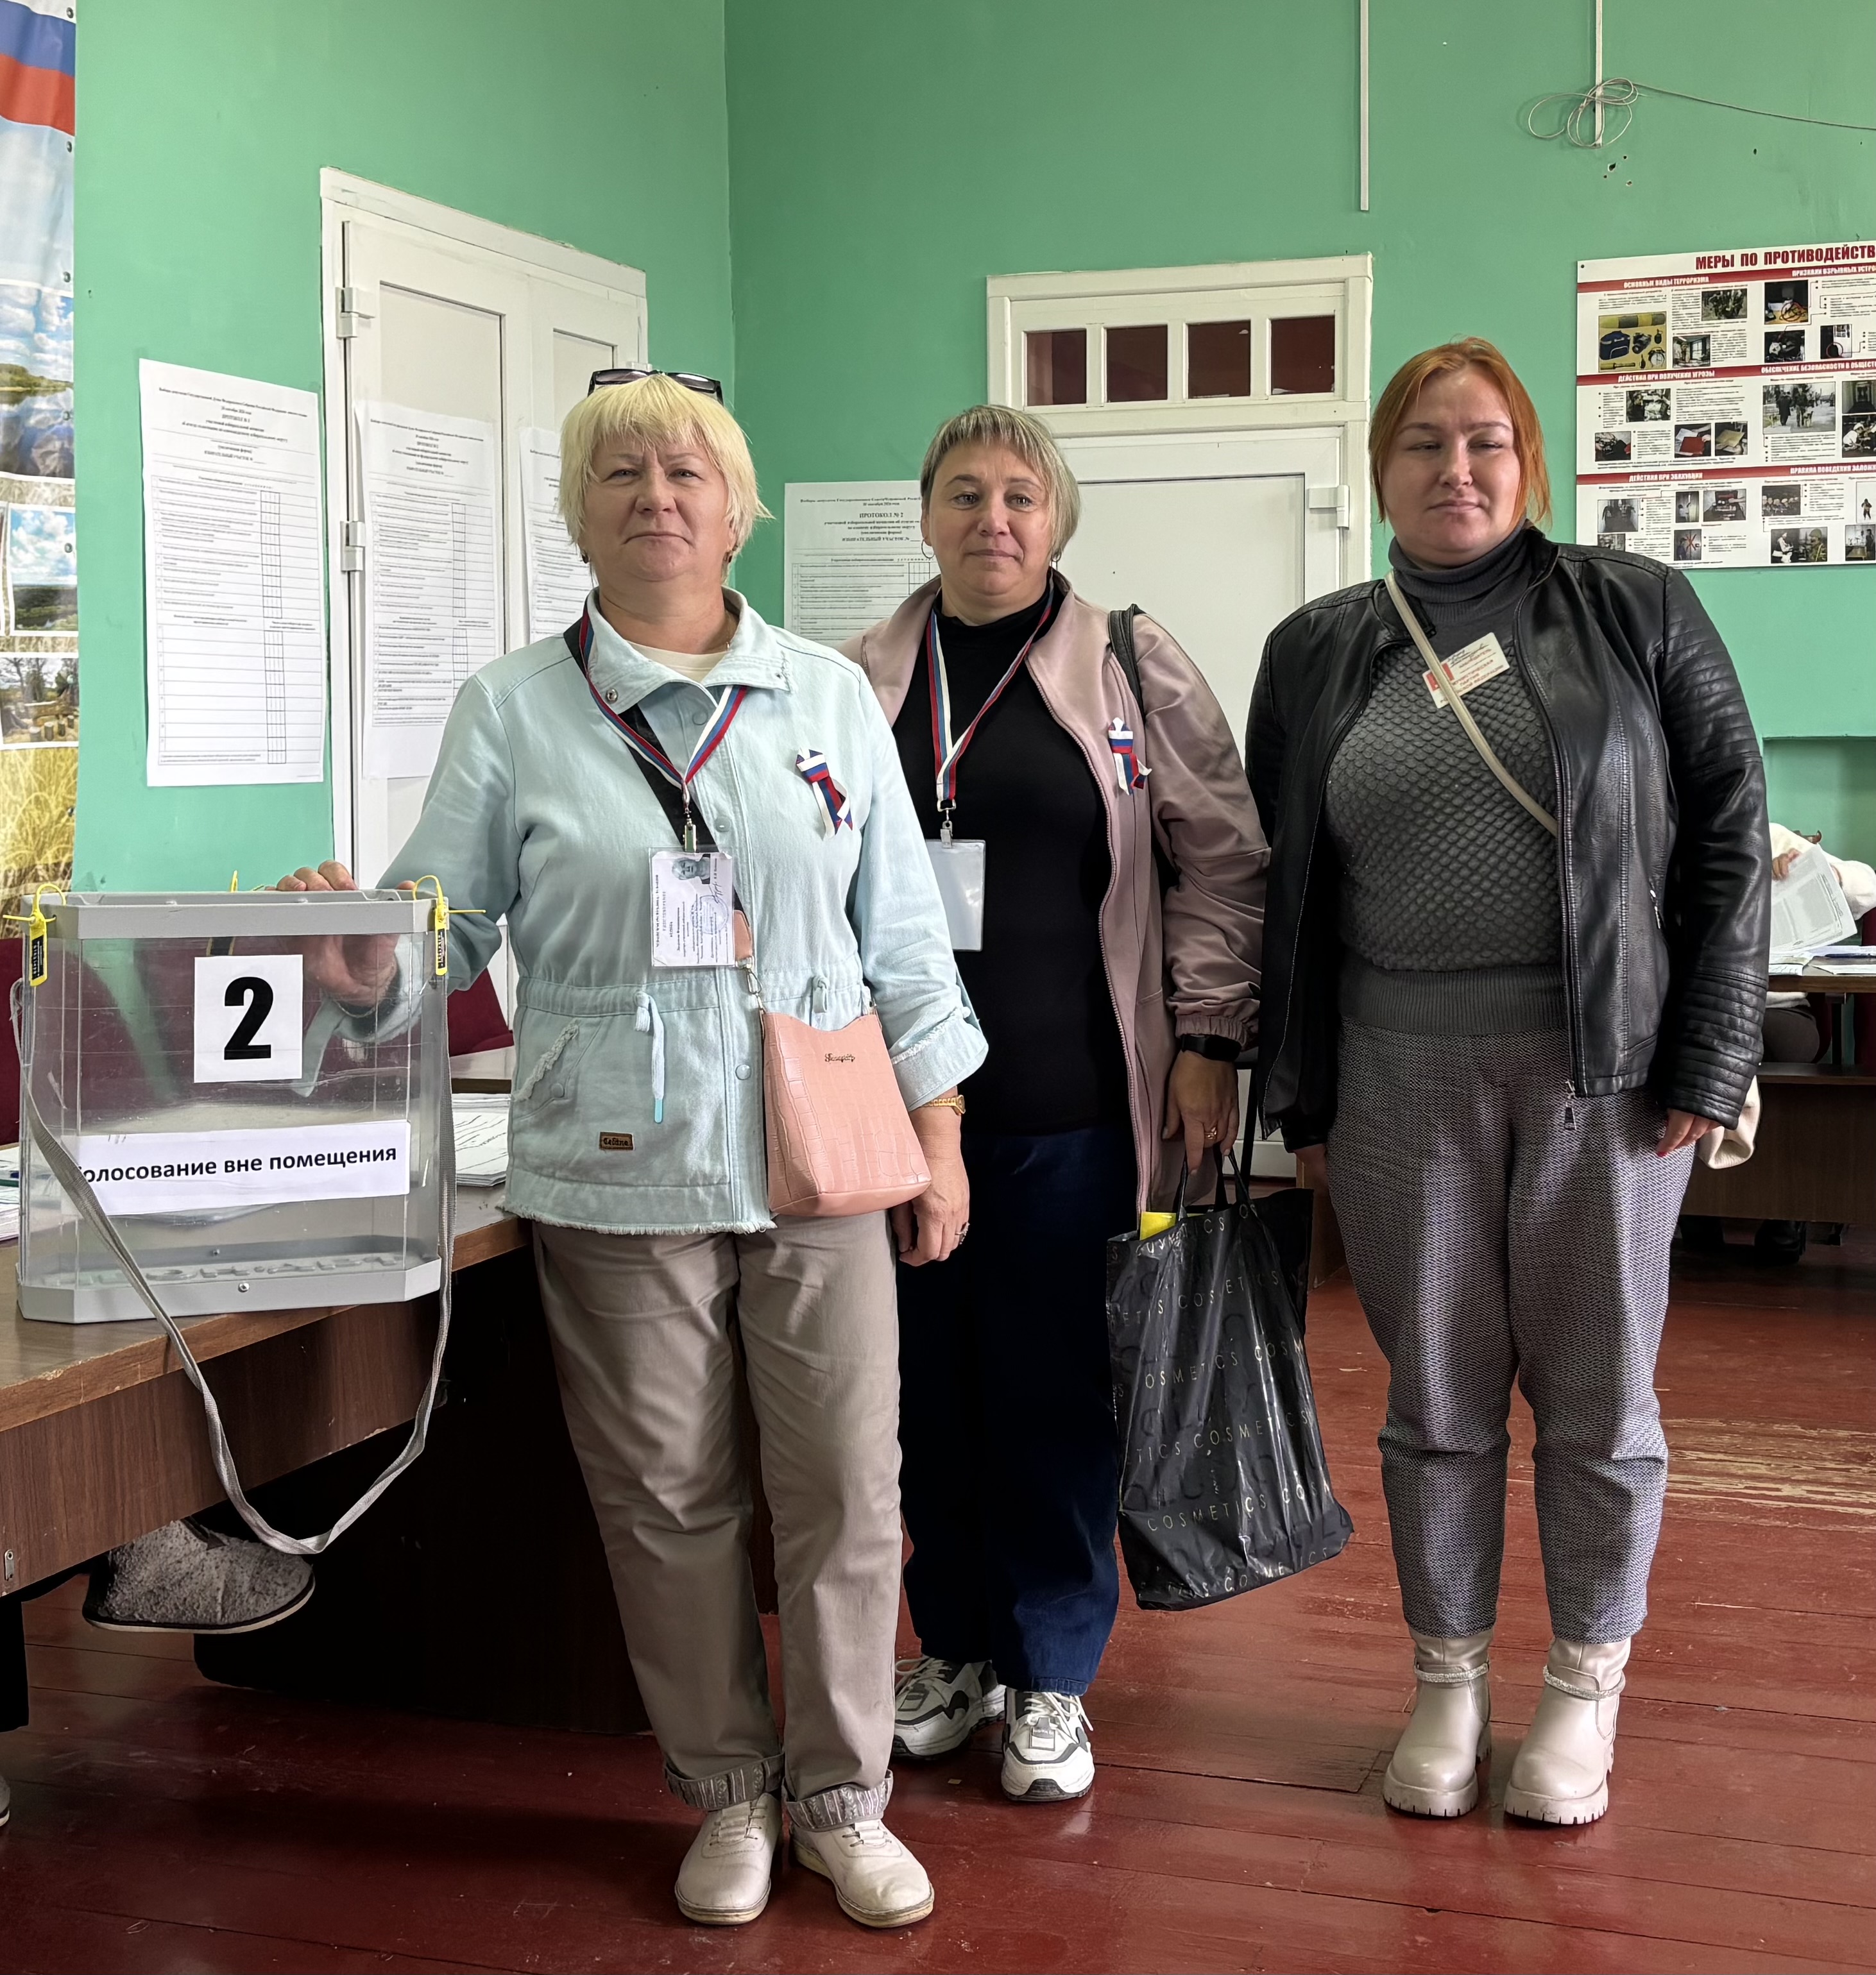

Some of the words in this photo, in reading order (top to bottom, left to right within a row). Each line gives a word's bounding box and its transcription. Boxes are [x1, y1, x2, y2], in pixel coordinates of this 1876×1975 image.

[1695, 254, 1735, 270] МЕРЫ
[1740, 252, 1758, 267] ПО
[1764, 244, 1875, 265] ПРОТИВОДЕЙСТВ
[1673, 276, 1709, 285] ТЕРРОРИЗМА
[223, 976, 274, 1061] 2
[78, 1158, 217, 1184] олосование
[225, 1158, 262, 1173] вне
[269, 1147, 397, 1170] помещения
[1147, 1494, 1267, 1532] COSMETICS
